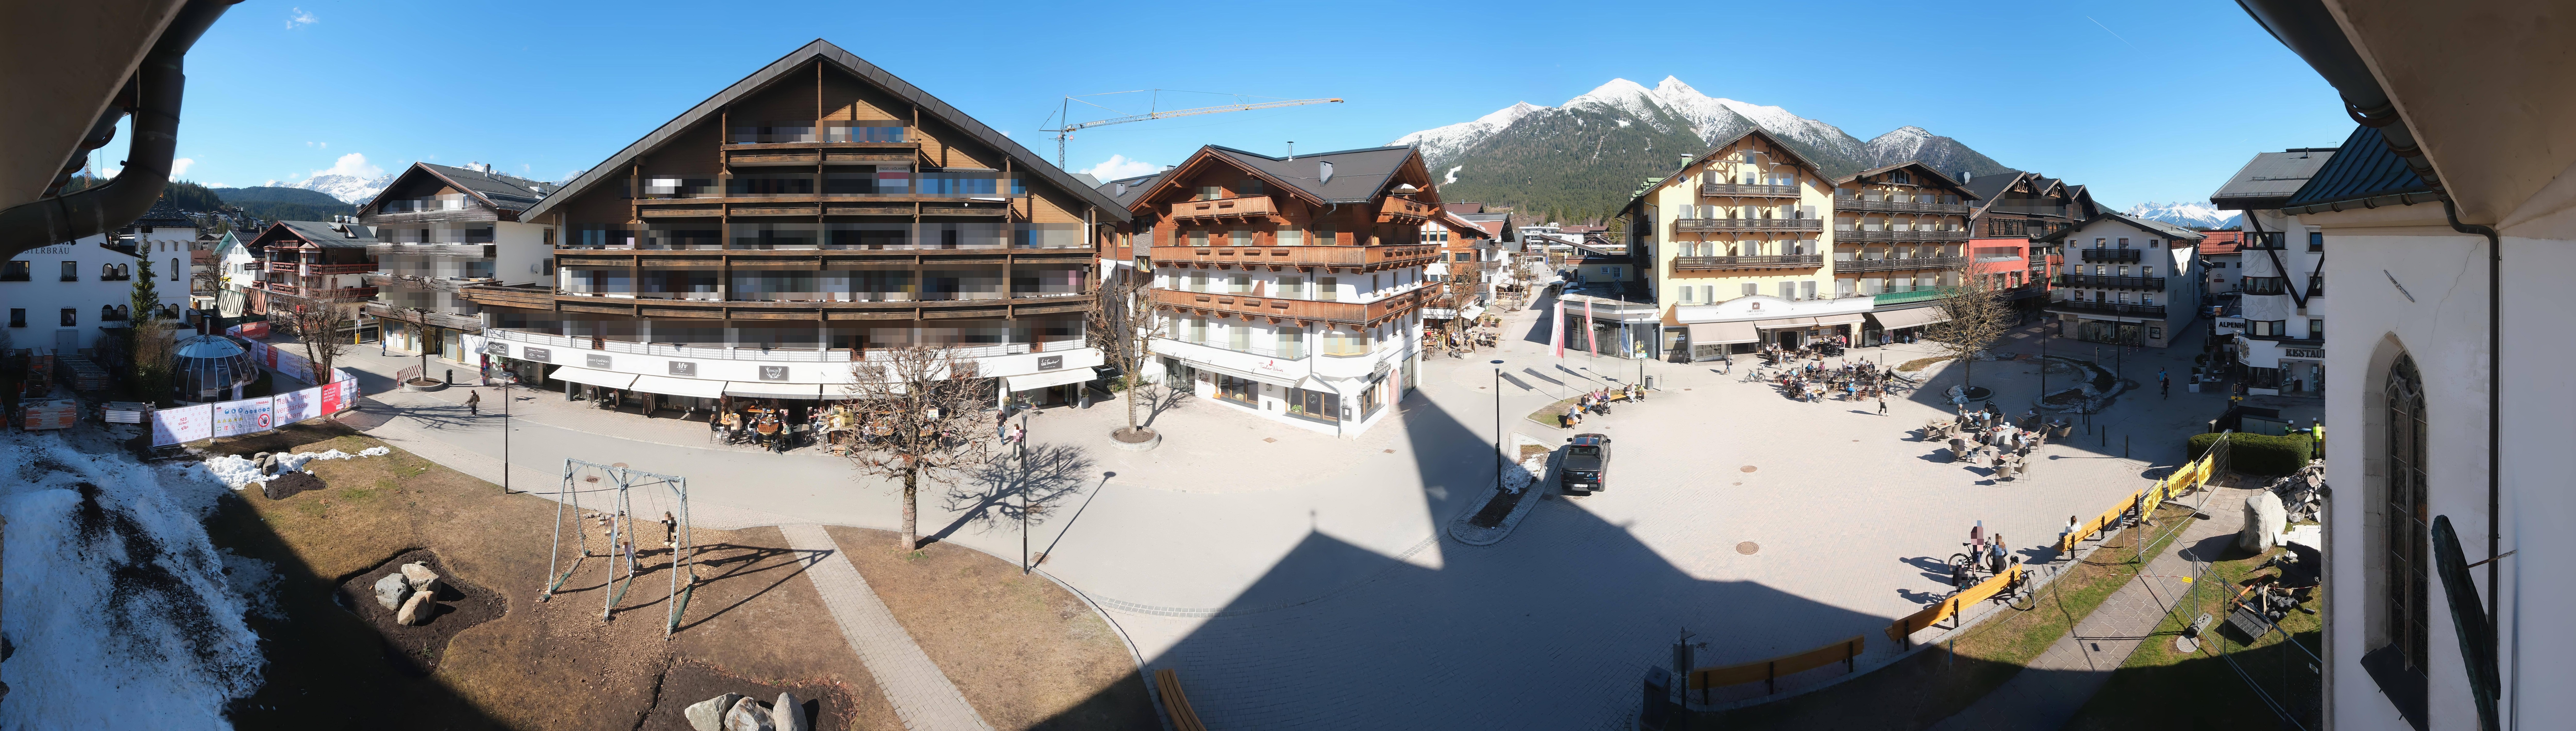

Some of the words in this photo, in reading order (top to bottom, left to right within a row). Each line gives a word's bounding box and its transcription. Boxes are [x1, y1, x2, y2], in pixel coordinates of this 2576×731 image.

[1406, 343, 1415, 352] SAILER
[676, 362, 688, 372] My
[1376, 365, 1390, 378] RESTAURANT
[277, 396, 289, 405] Hall
[297, 392, 310, 401] Tirol
[277, 403, 309, 413] verstärken.
